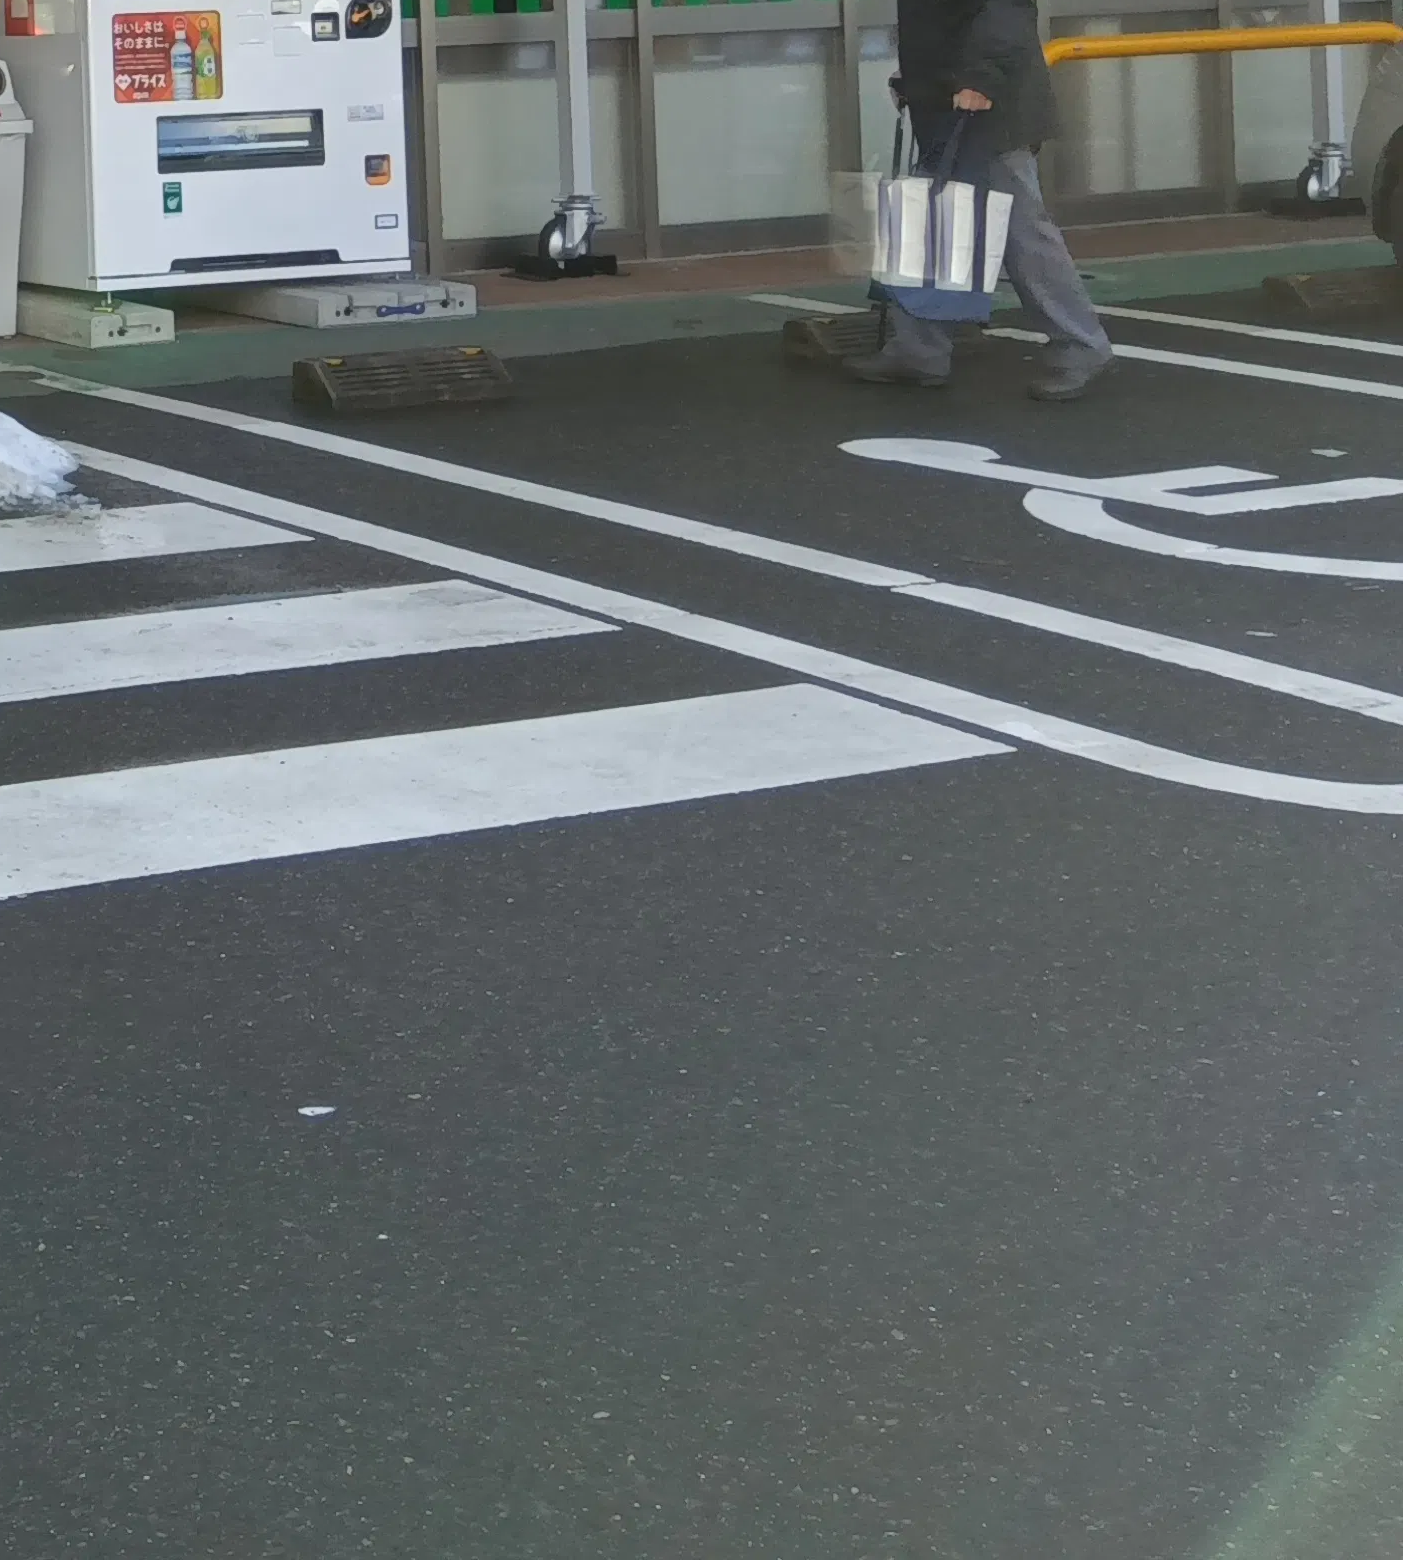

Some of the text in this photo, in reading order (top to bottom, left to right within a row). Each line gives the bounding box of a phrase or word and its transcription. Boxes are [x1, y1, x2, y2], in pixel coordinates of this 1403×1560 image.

[114, 20, 164, 34] おいしさは
